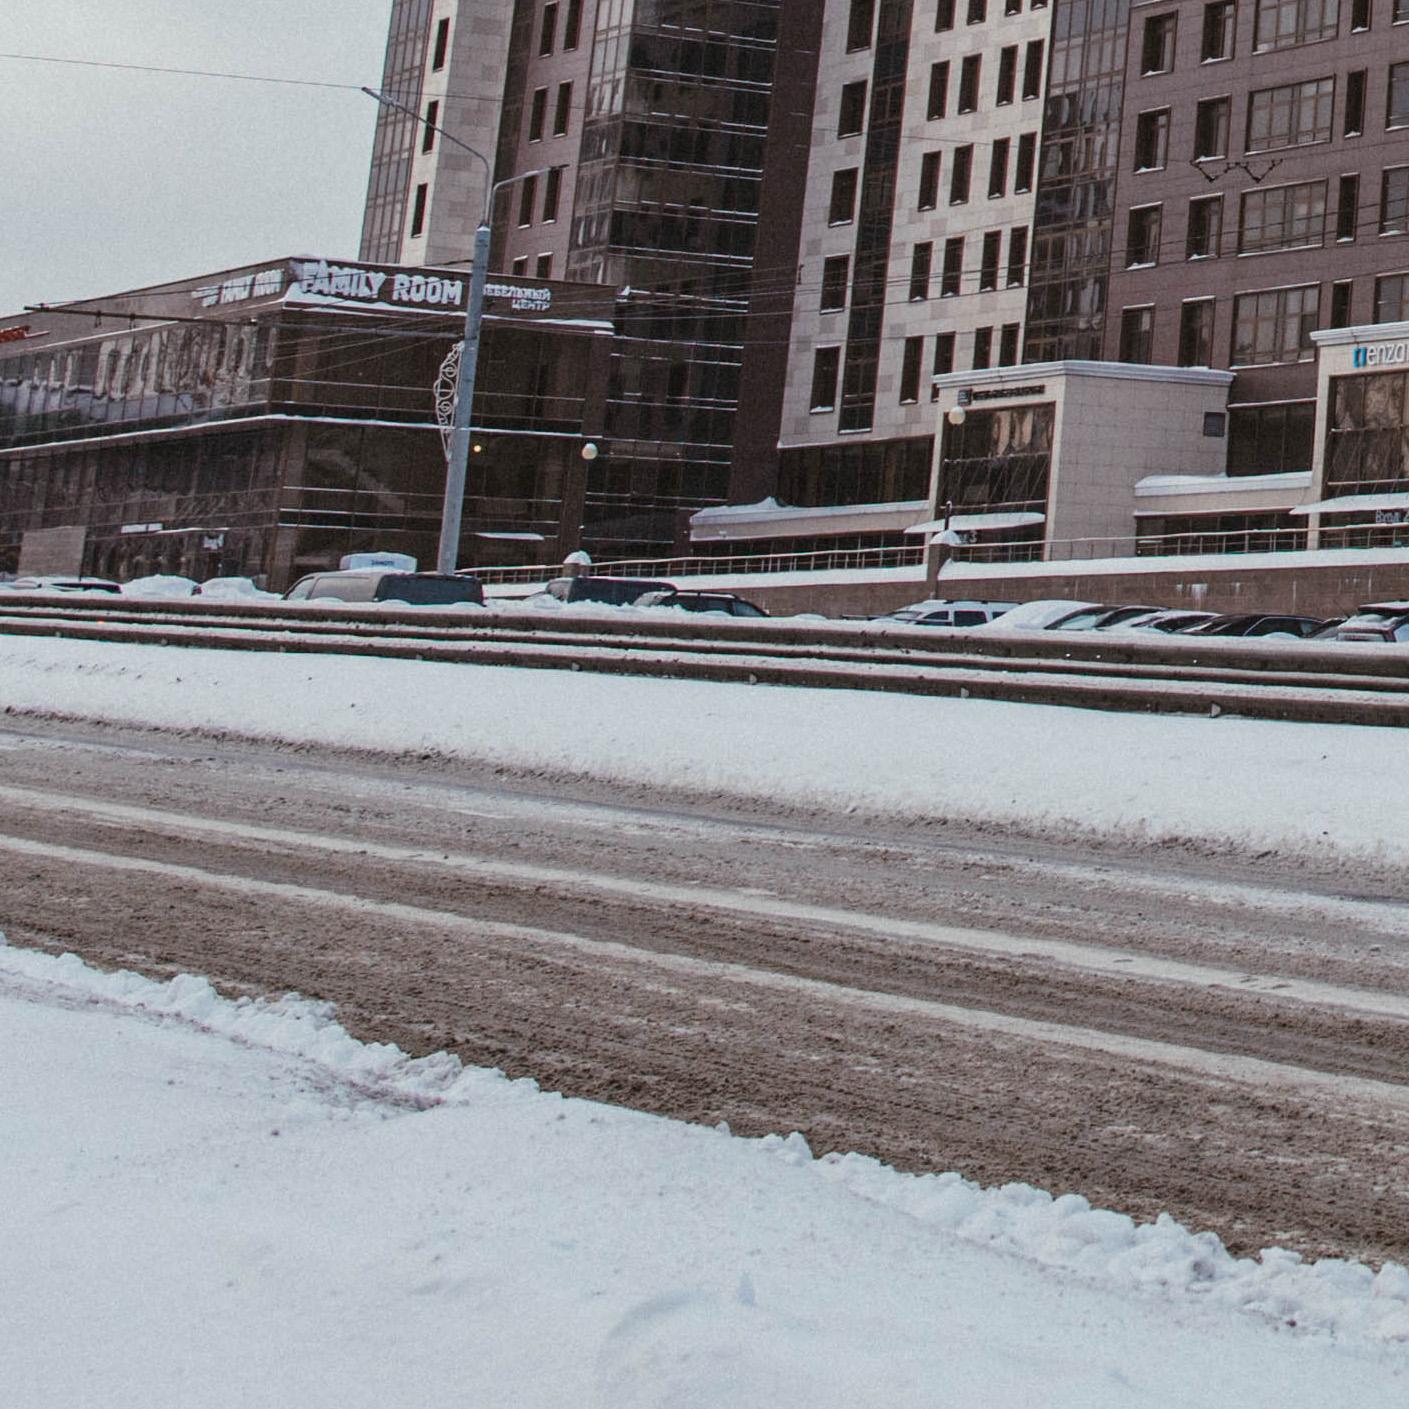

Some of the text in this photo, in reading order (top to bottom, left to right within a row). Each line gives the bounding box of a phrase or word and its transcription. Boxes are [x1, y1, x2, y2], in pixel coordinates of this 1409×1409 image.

[302, 259, 463, 306] FAMILY ROOM
[511, 299, 551, 312] ЦЕНТР
